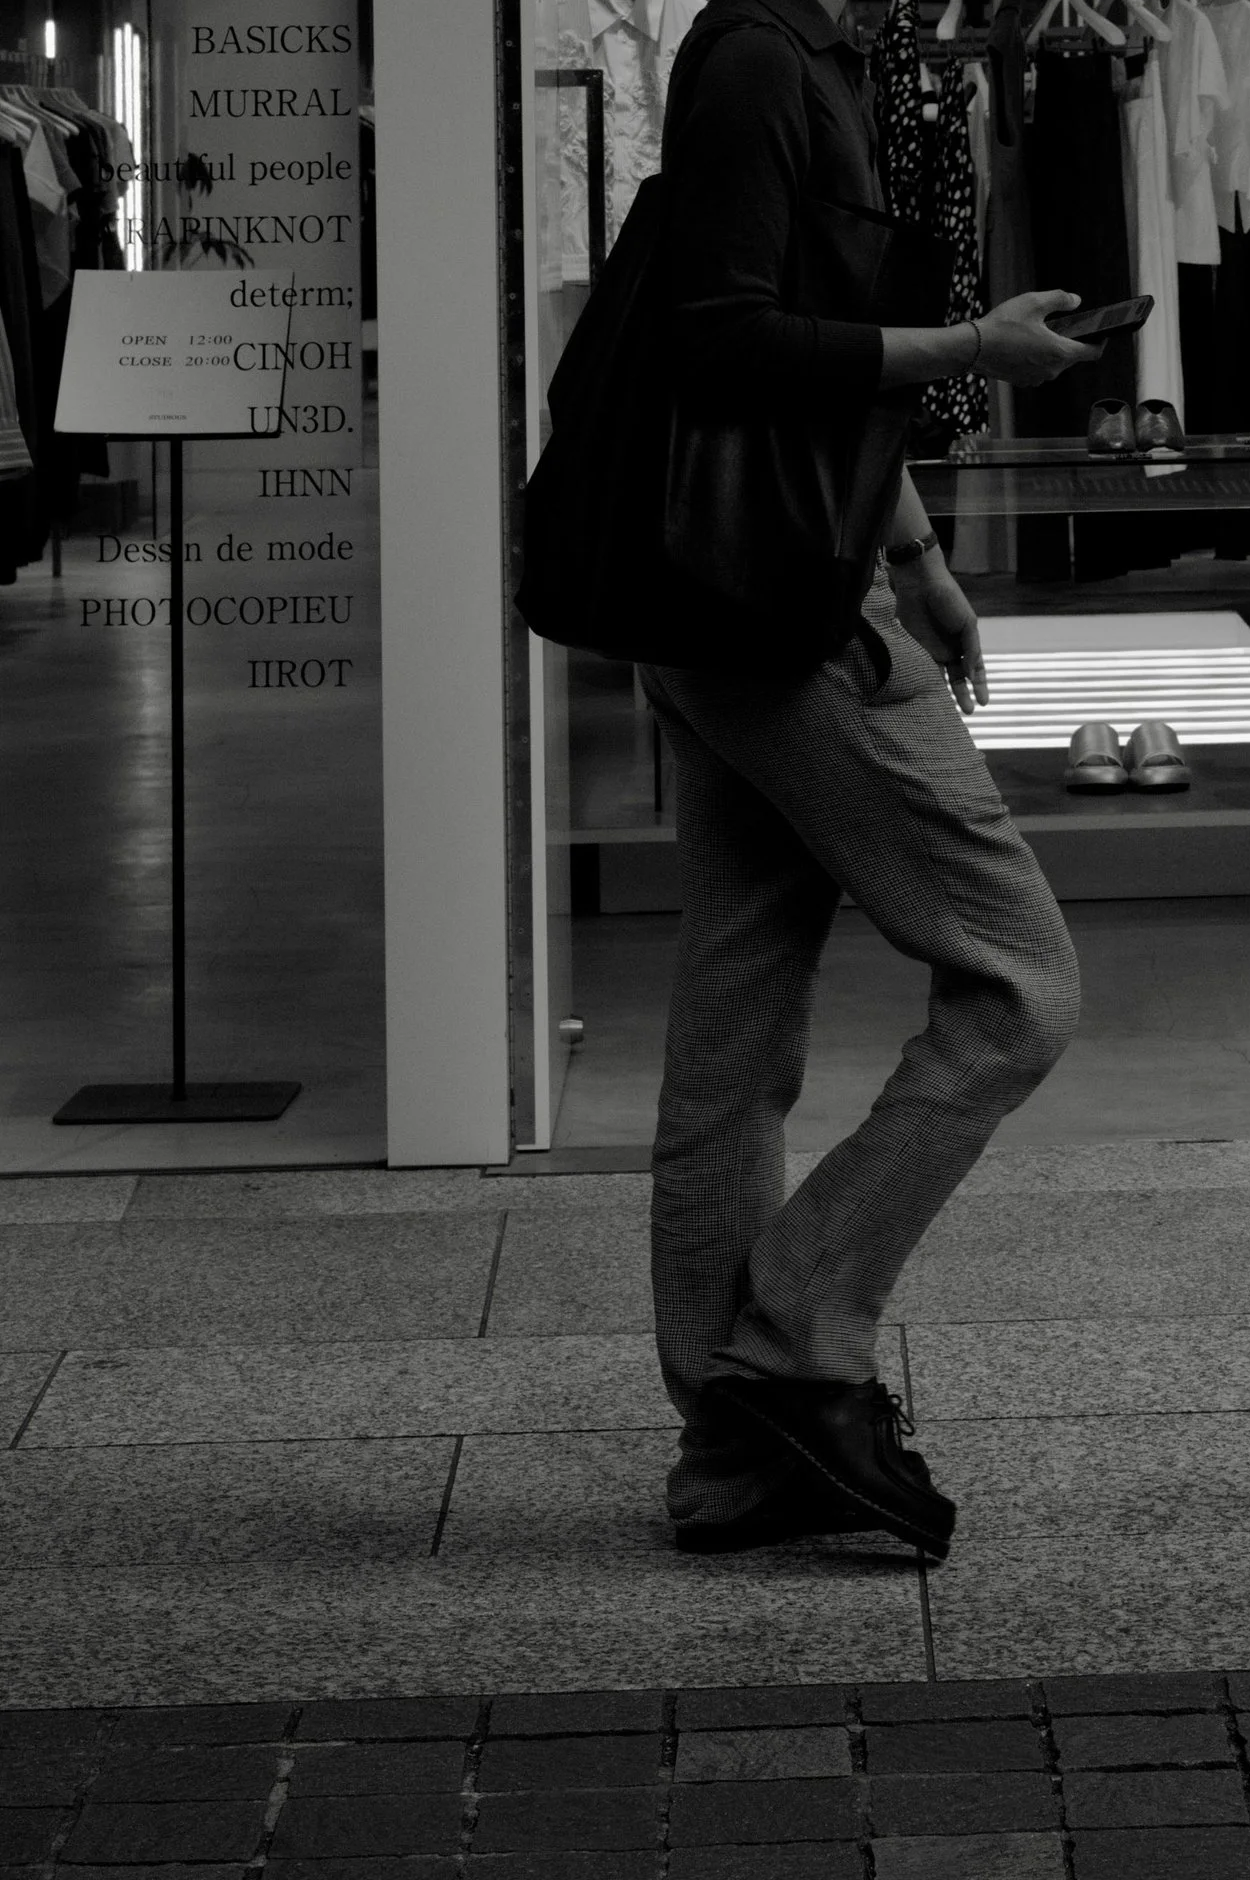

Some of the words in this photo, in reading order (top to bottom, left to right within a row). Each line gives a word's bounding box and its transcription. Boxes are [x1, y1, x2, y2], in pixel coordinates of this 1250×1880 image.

[192, 23, 352, 55] BASICKS
[189, 87, 352, 118] MURRAL
[97, 153, 236, 184] beautful
[250, 153, 352, 187] people
[98, 213, 352, 245] RAPINKNOT
[230, 279, 354, 310] determ;
[121, 334, 169, 347] OPEN
[188, 333, 233, 347] 12:00
[118, 355, 172, 368] CLOSE
[184, 355, 231, 368] 20:00
[233, 341, 352, 372] CINOH
[249, 404, 354, 436] UN3D.
[258, 468, 353, 498] IHNN
[96, 534, 203, 563] Dessn
[216, 533, 254, 563] de
[267, 531, 354, 562] mode
[248, 658, 354, 689] IIROT
